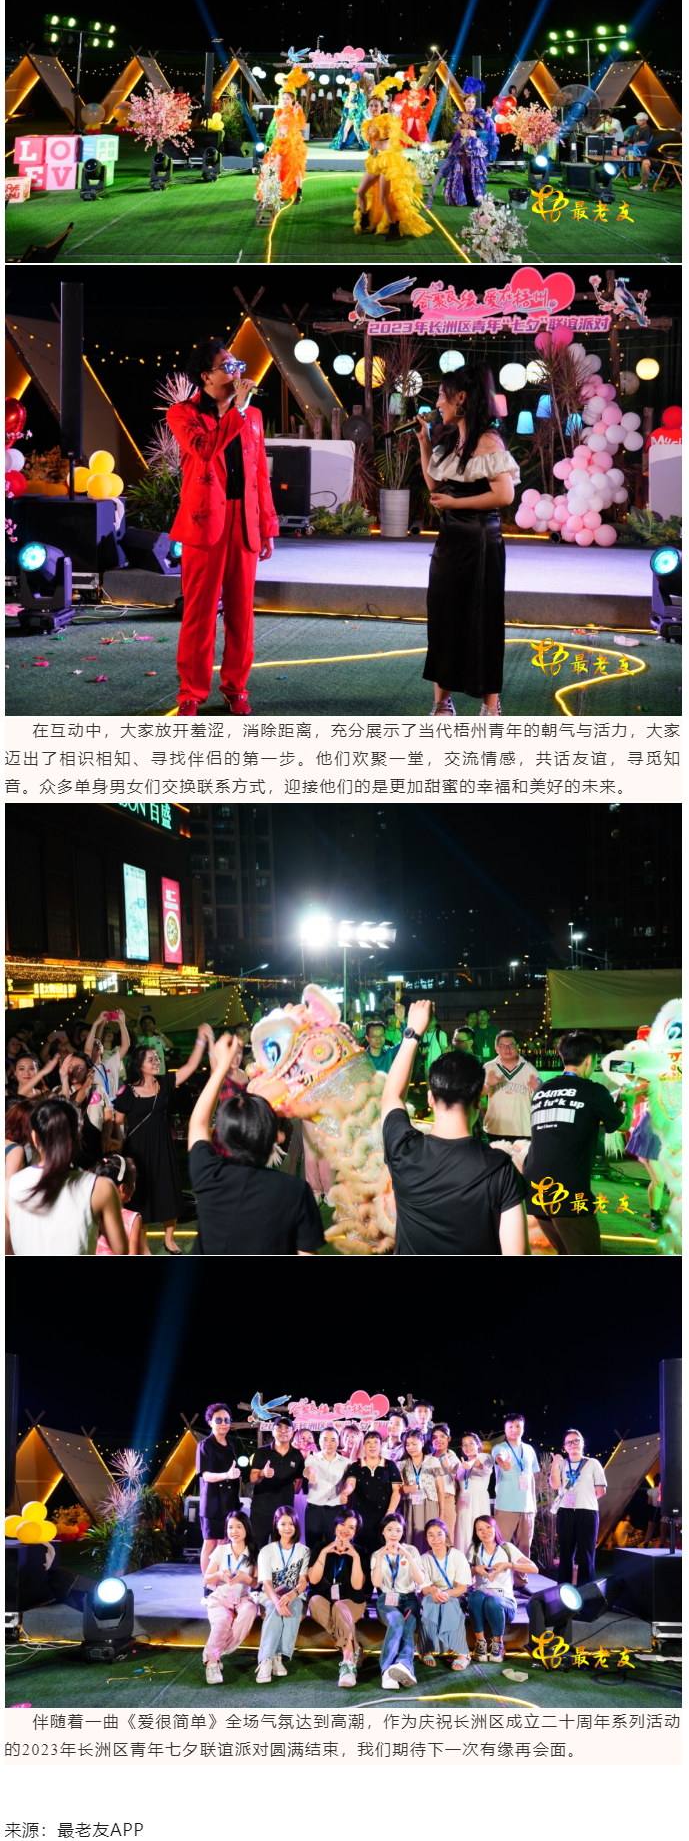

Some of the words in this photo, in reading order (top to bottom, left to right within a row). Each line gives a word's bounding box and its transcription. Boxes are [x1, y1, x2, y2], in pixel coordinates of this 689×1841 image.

[413, 285, 479, 310] 会聚良缘
[483, 285, 550, 309] 爱在梧州
